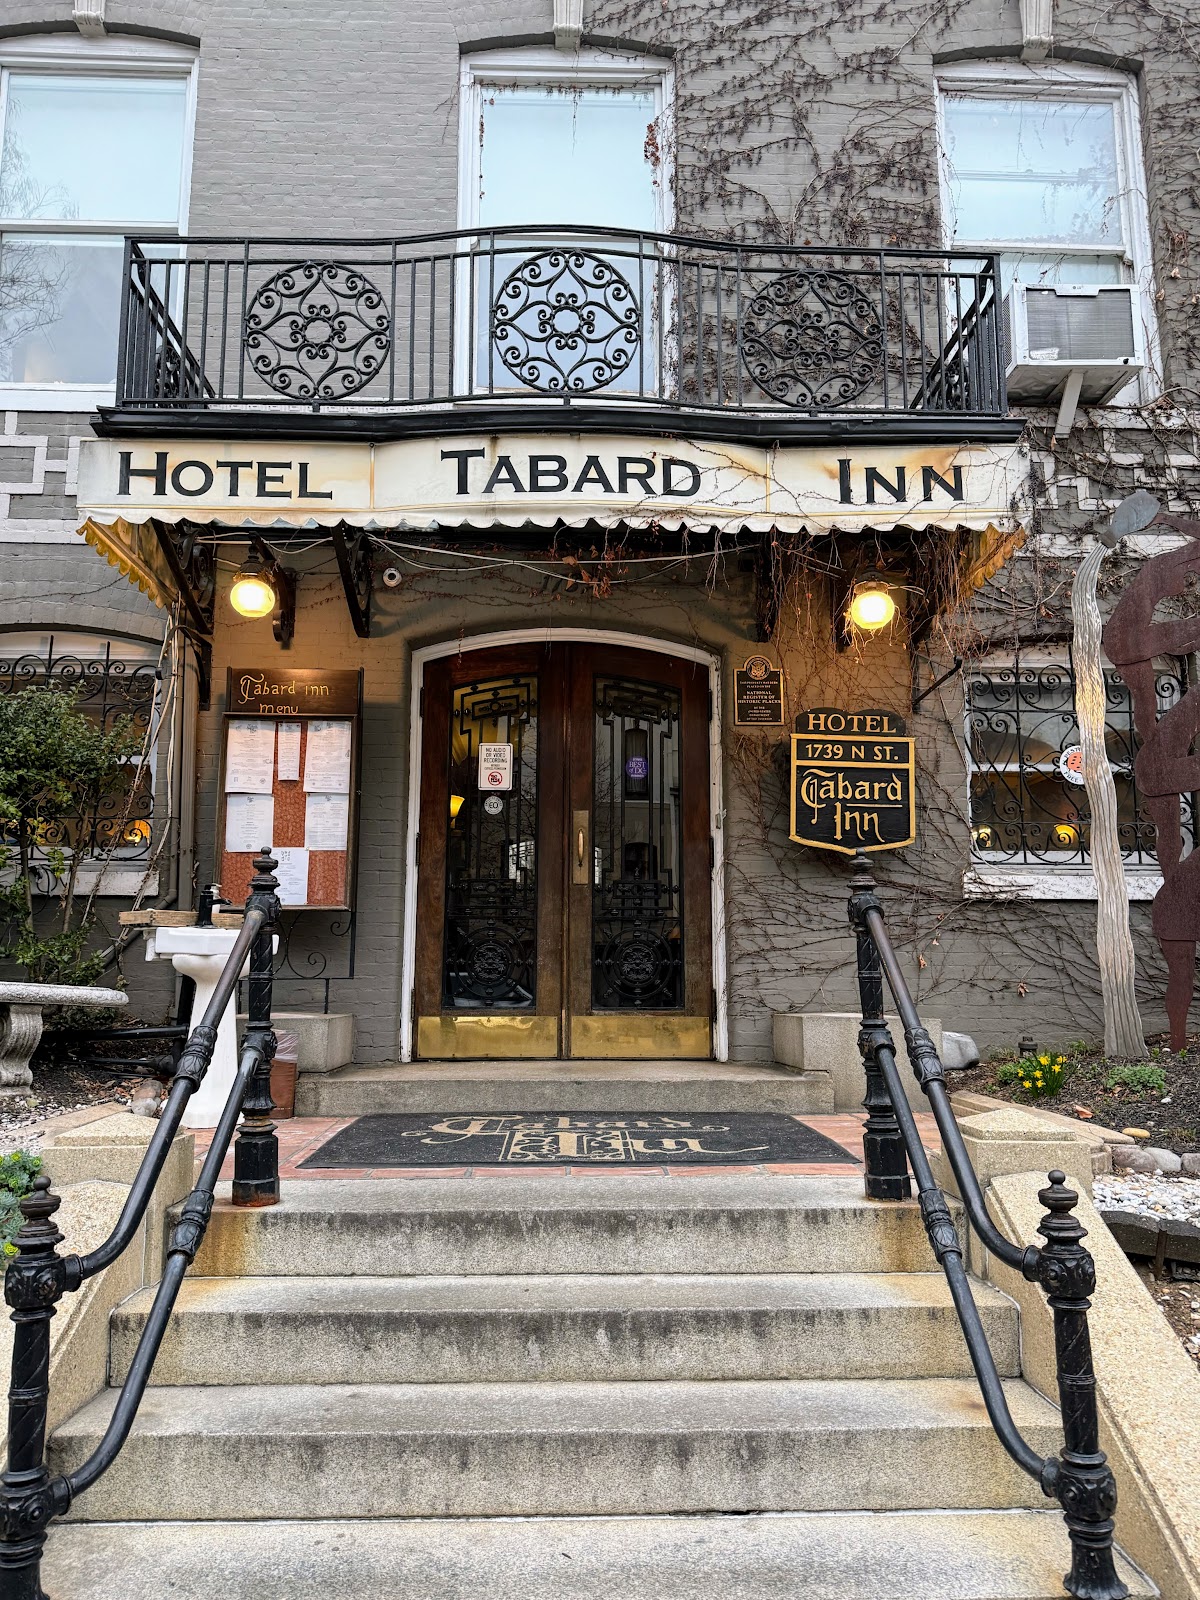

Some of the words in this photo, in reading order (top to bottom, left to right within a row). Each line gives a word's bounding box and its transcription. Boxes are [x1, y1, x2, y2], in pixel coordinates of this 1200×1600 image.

[117, 451, 333, 500] HOTEL
[441, 447, 702, 497] TABARD
[837, 458, 965, 505] INN
[238, 673, 296, 704] Tabard
[259, 703, 299, 714] menu
[807, 713, 897, 733] HOTEL
[805, 744, 844, 759] 1739
[851, 745, 865, 759] N
[873, 746, 899, 760] ST.
[801, 769, 903, 824] Tabard
[833, 801, 886, 842] Inn
